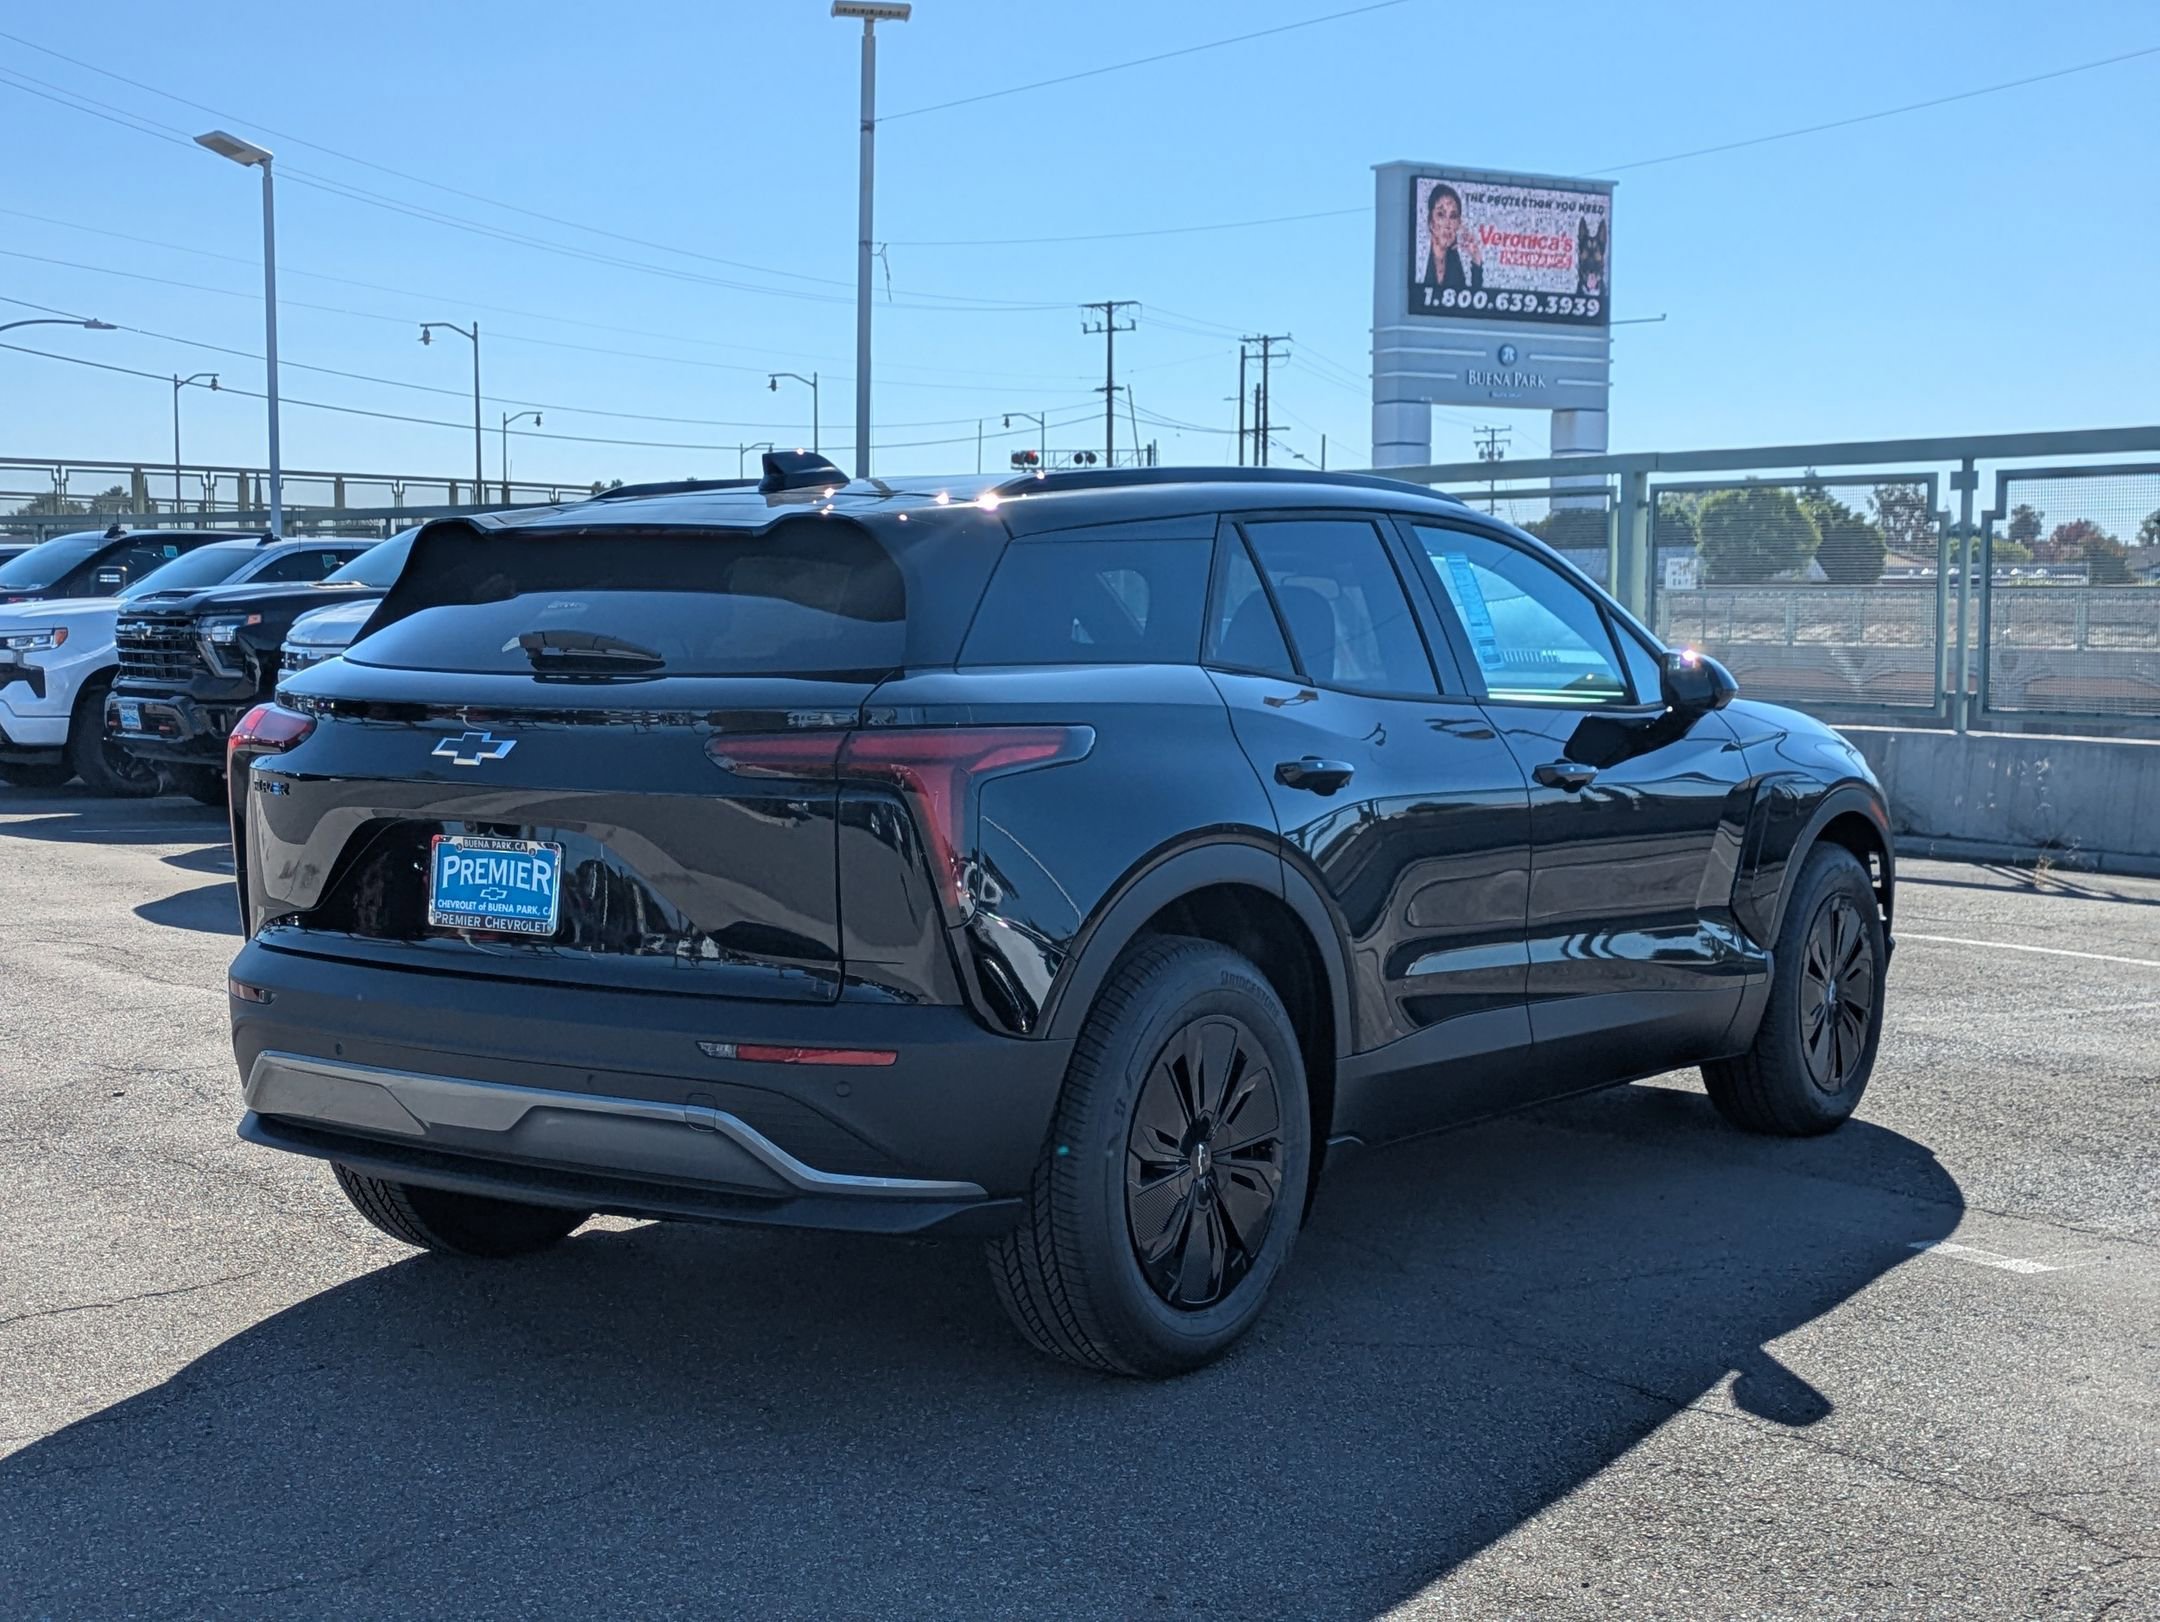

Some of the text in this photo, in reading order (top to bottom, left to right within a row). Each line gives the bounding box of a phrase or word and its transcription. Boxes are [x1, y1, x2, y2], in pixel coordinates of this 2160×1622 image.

[1465, 192, 1604, 215] THE PROTECTION YOU NEED
[1479, 223, 1573, 252] Veronica's
[1423, 286, 1600, 317] 1.800.639.3939
[1468, 369, 1546, 388] BUENA PARK
[464, 838, 490, 849] BUENA
[442, 855, 551, 896] PREMIER
[438, 899, 477, 910] CHEVROLET
[478, 902, 487, 911] of
[488, 903, 514, 913] BUENA
[516, 905, 540, 916] PARK,
[435, 911, 548, 933] PREMIER CHEVROLET
